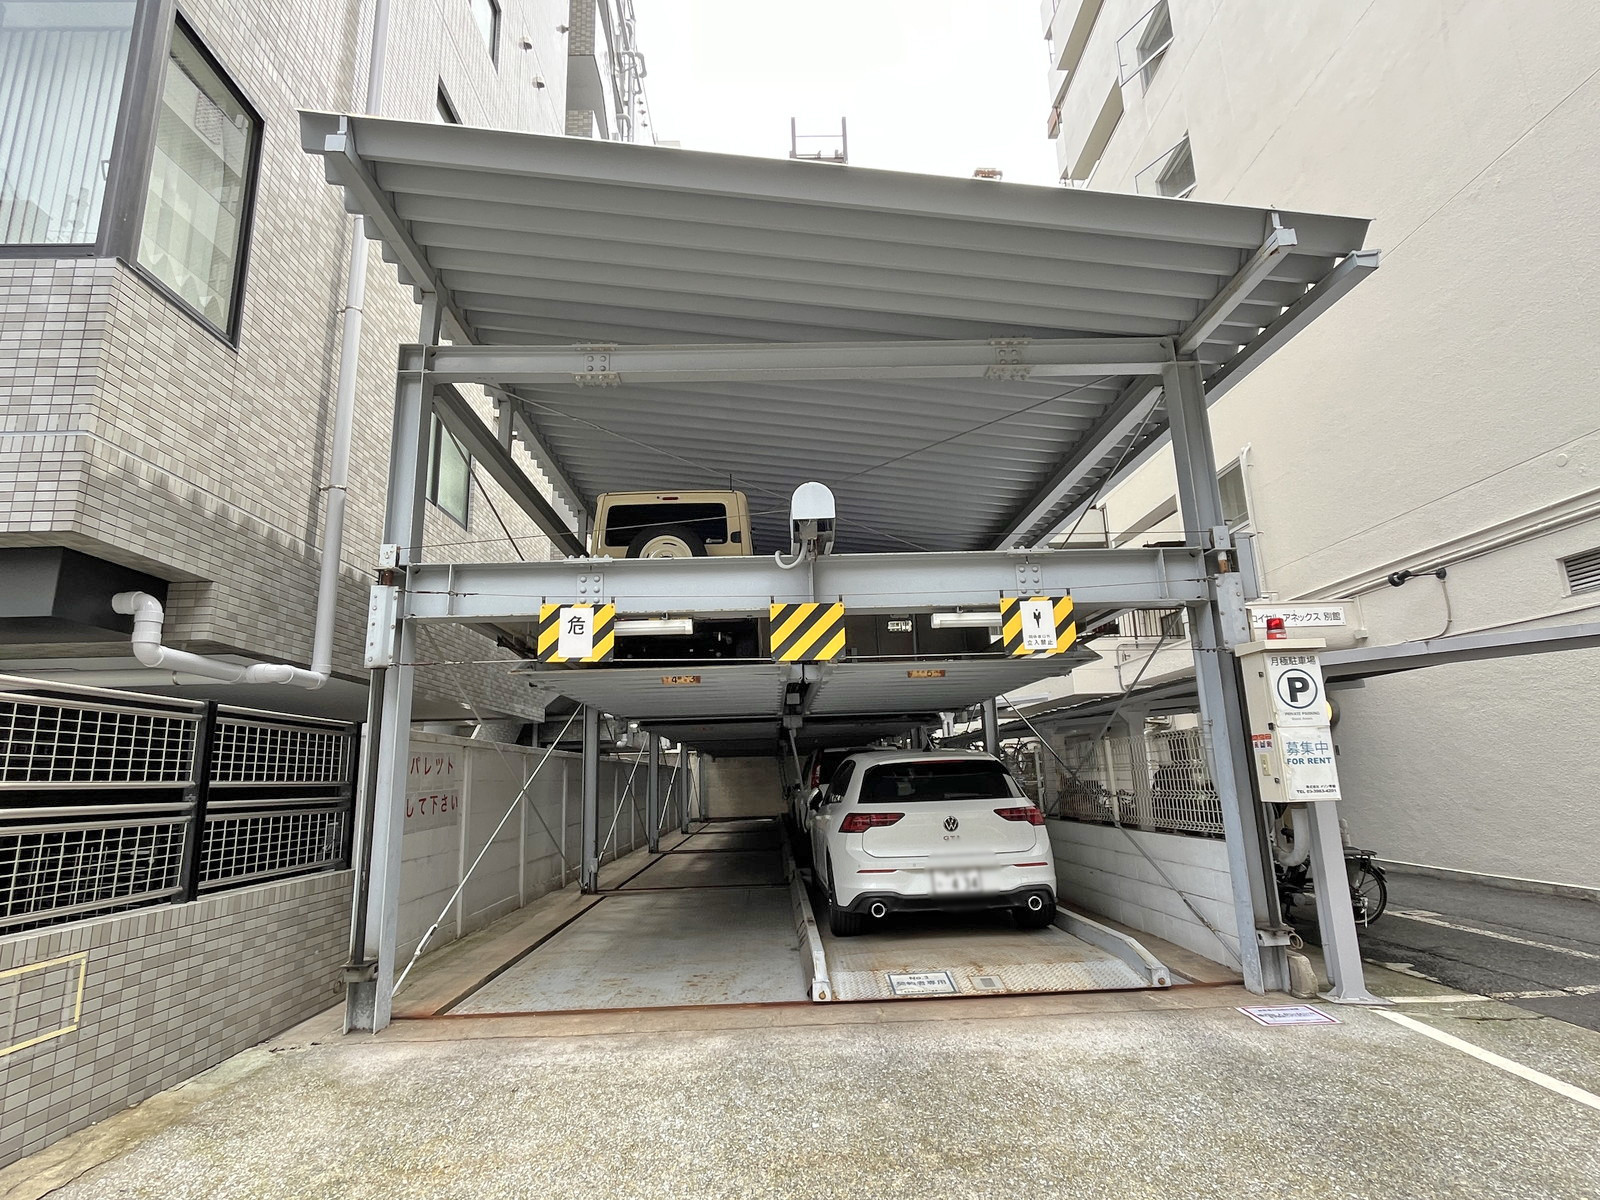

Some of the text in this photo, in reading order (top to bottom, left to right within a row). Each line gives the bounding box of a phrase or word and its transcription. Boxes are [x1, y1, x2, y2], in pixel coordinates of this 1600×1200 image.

[1323, 611, 1341, 621] 別館
[568, 616, 586, 635] 危
[1271, 656, 1315, 666] 月極駐車場
[1287, 677, 1310, 703] P
[1286, 740, 1329, 756] 募集中
[1287, 756, 1332, 765] FOR RENT
[406, 794, 459, 818] して下さい
